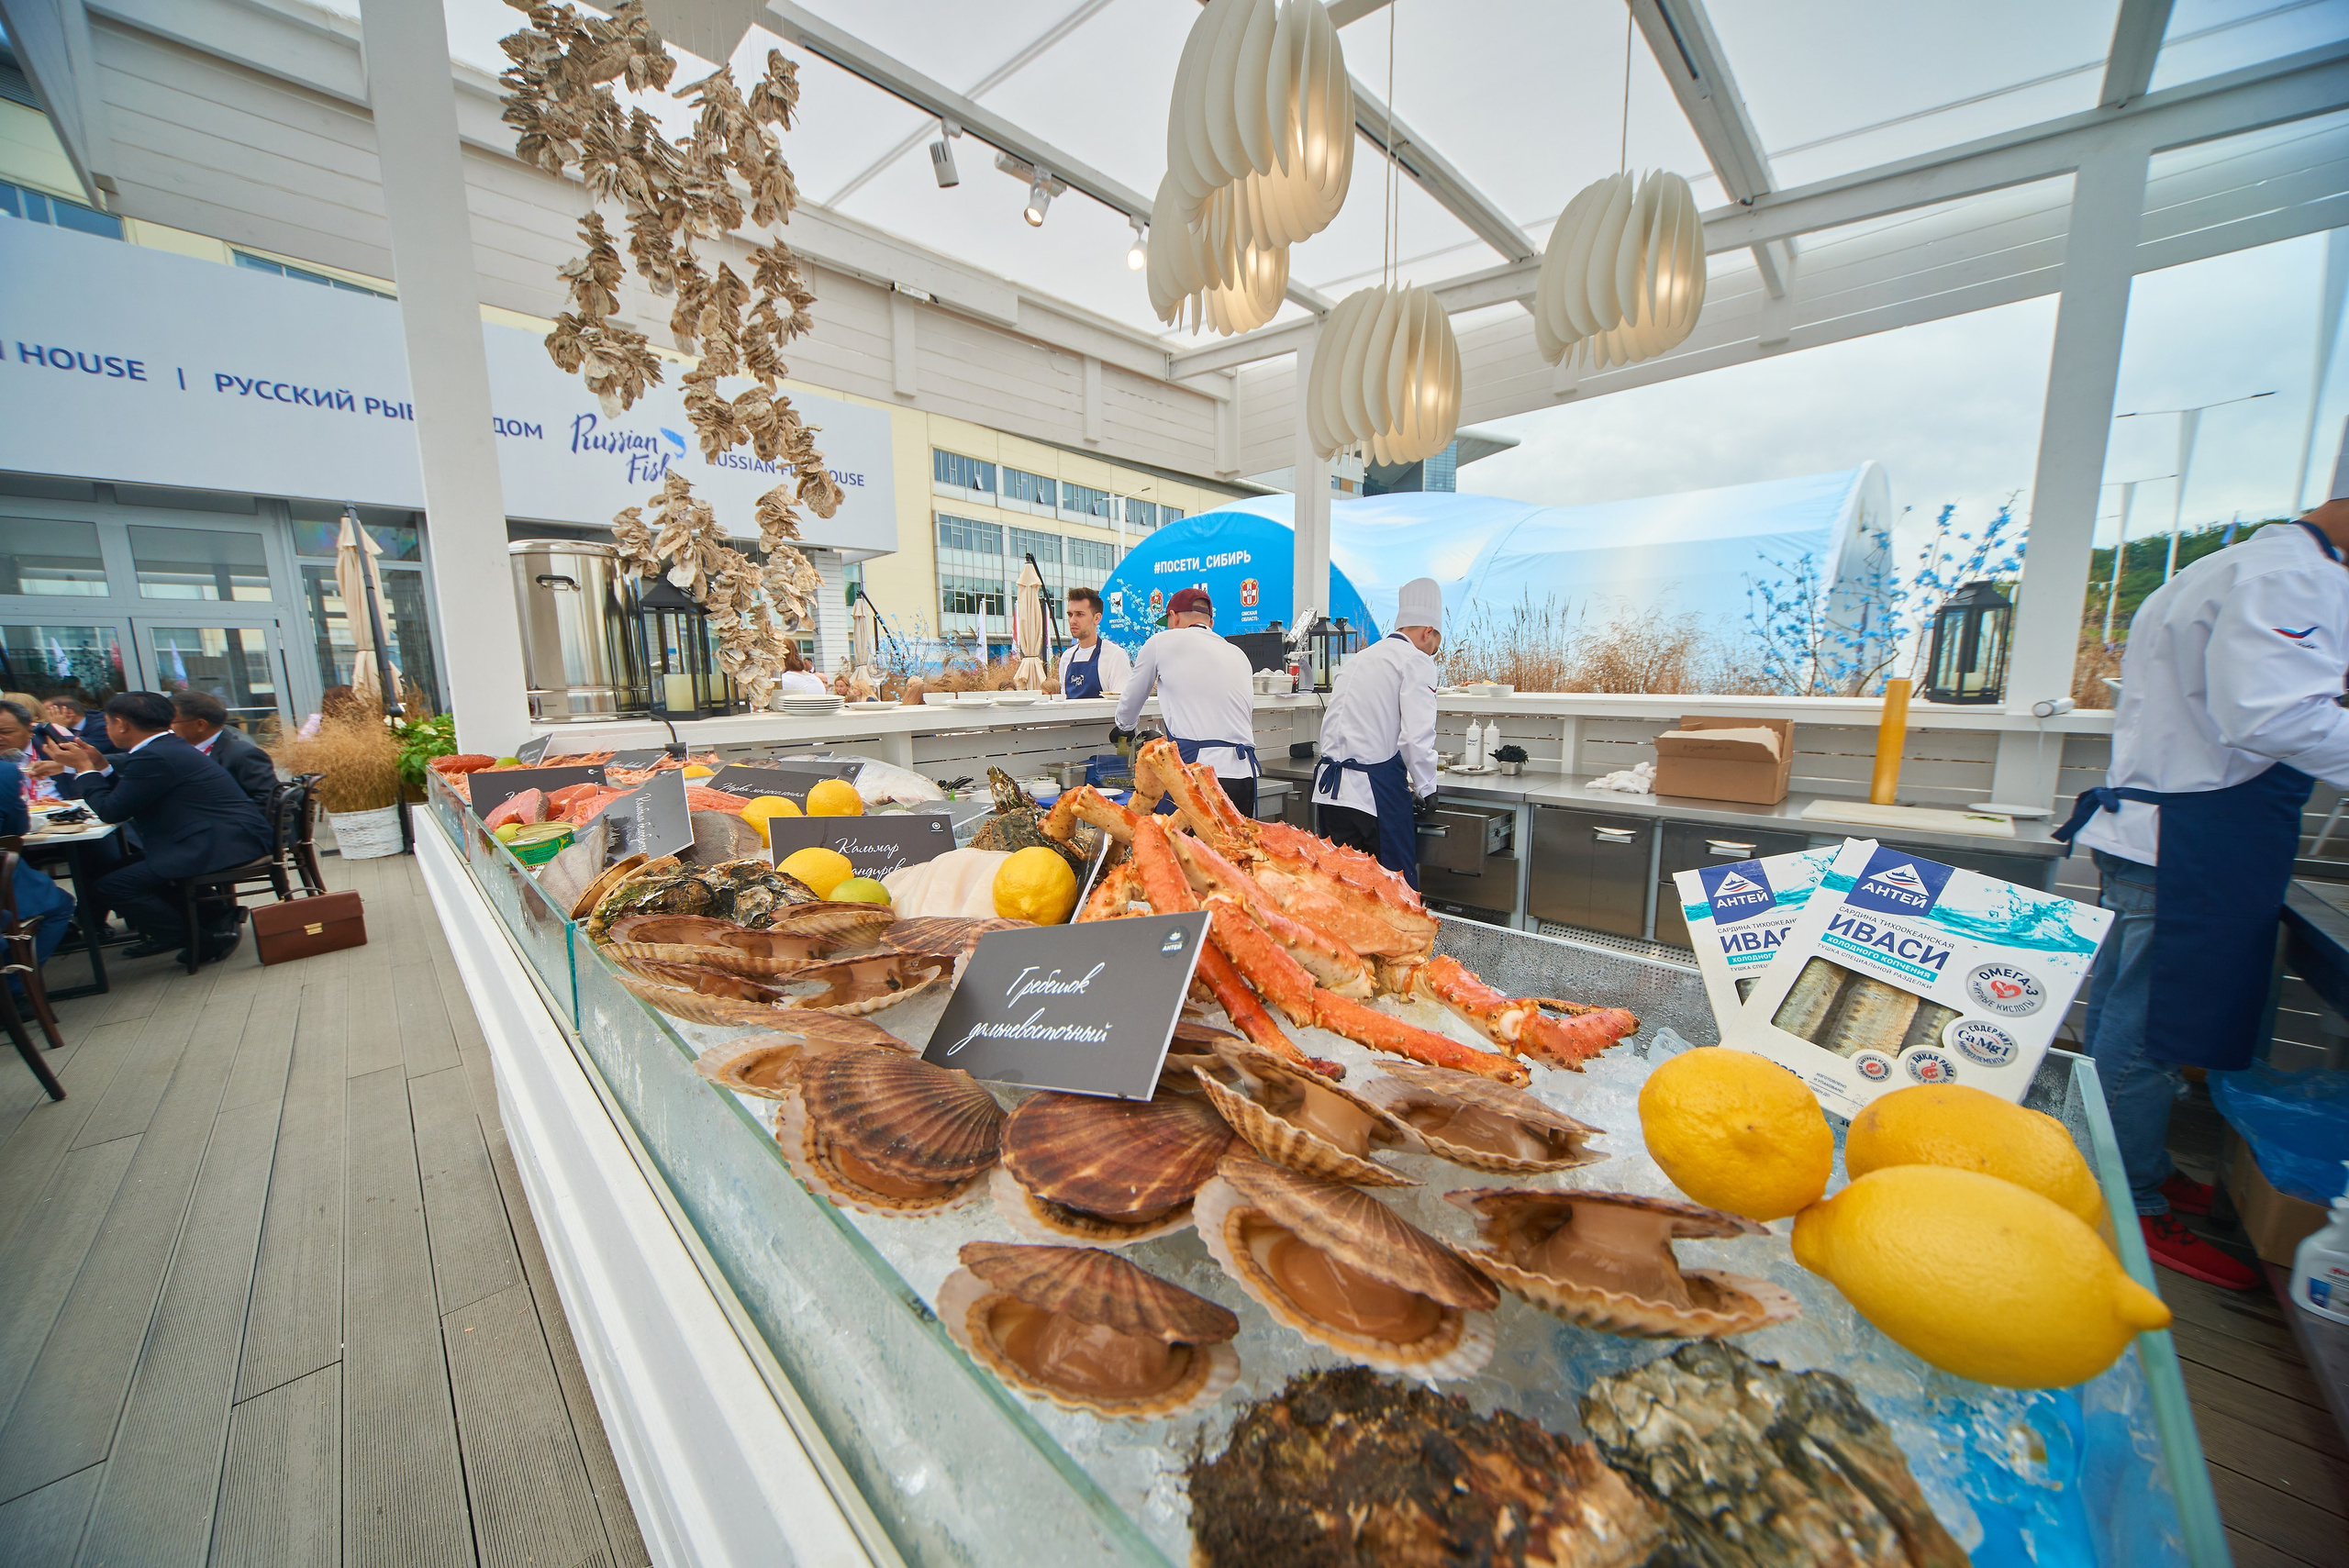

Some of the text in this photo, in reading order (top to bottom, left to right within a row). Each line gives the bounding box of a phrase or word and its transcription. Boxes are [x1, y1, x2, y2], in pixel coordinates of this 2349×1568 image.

[16, 340, 148, 382] HOUSE
[214, 372, 356, 412] РУССКИЙ
[570, 413, 659, 455] Russian
[829, 470, 865, 486] OUSE
[1153, 550, 1252, 574] #ПОСЕТИ_СИБИРЬ
[835, 837, 899, 860] Кальмар
[1717, 891, 1769, 908] АНТЕЙ
[1861, 882, 1928, 909] АНТЕЙ
[1717, 924, 1752, 934] САРДИНА
[1827, 913, 1951, 971] ИВАСИ
[1838, 906, 1955, 950] САРДИНА ТИХООКЕАНСКАЯ
[1818, 942, 1932, 990] ТУШКА СПЕЦИАЛЬНОЙ РАЗДЕЛКИ
[1006, 962, 1106, 1009] Гребешок
[1978, 967, 2039, 996] ОМЕГА-3
[1973, 980, 2035, 1013] ЖИРНЫЕ КИСЛОТЫ
[947, 1007, 1113, 1056] дальневосточный
[1957, 1029, 1976, 1043] Ca
[1976, 1037, 2001, 1055] Mg
[1968, 1024, 2013, 1047] СОДЕРЖИТ
[1911, 1053, 1954, 1077] ДИКАЯ РЫБА
